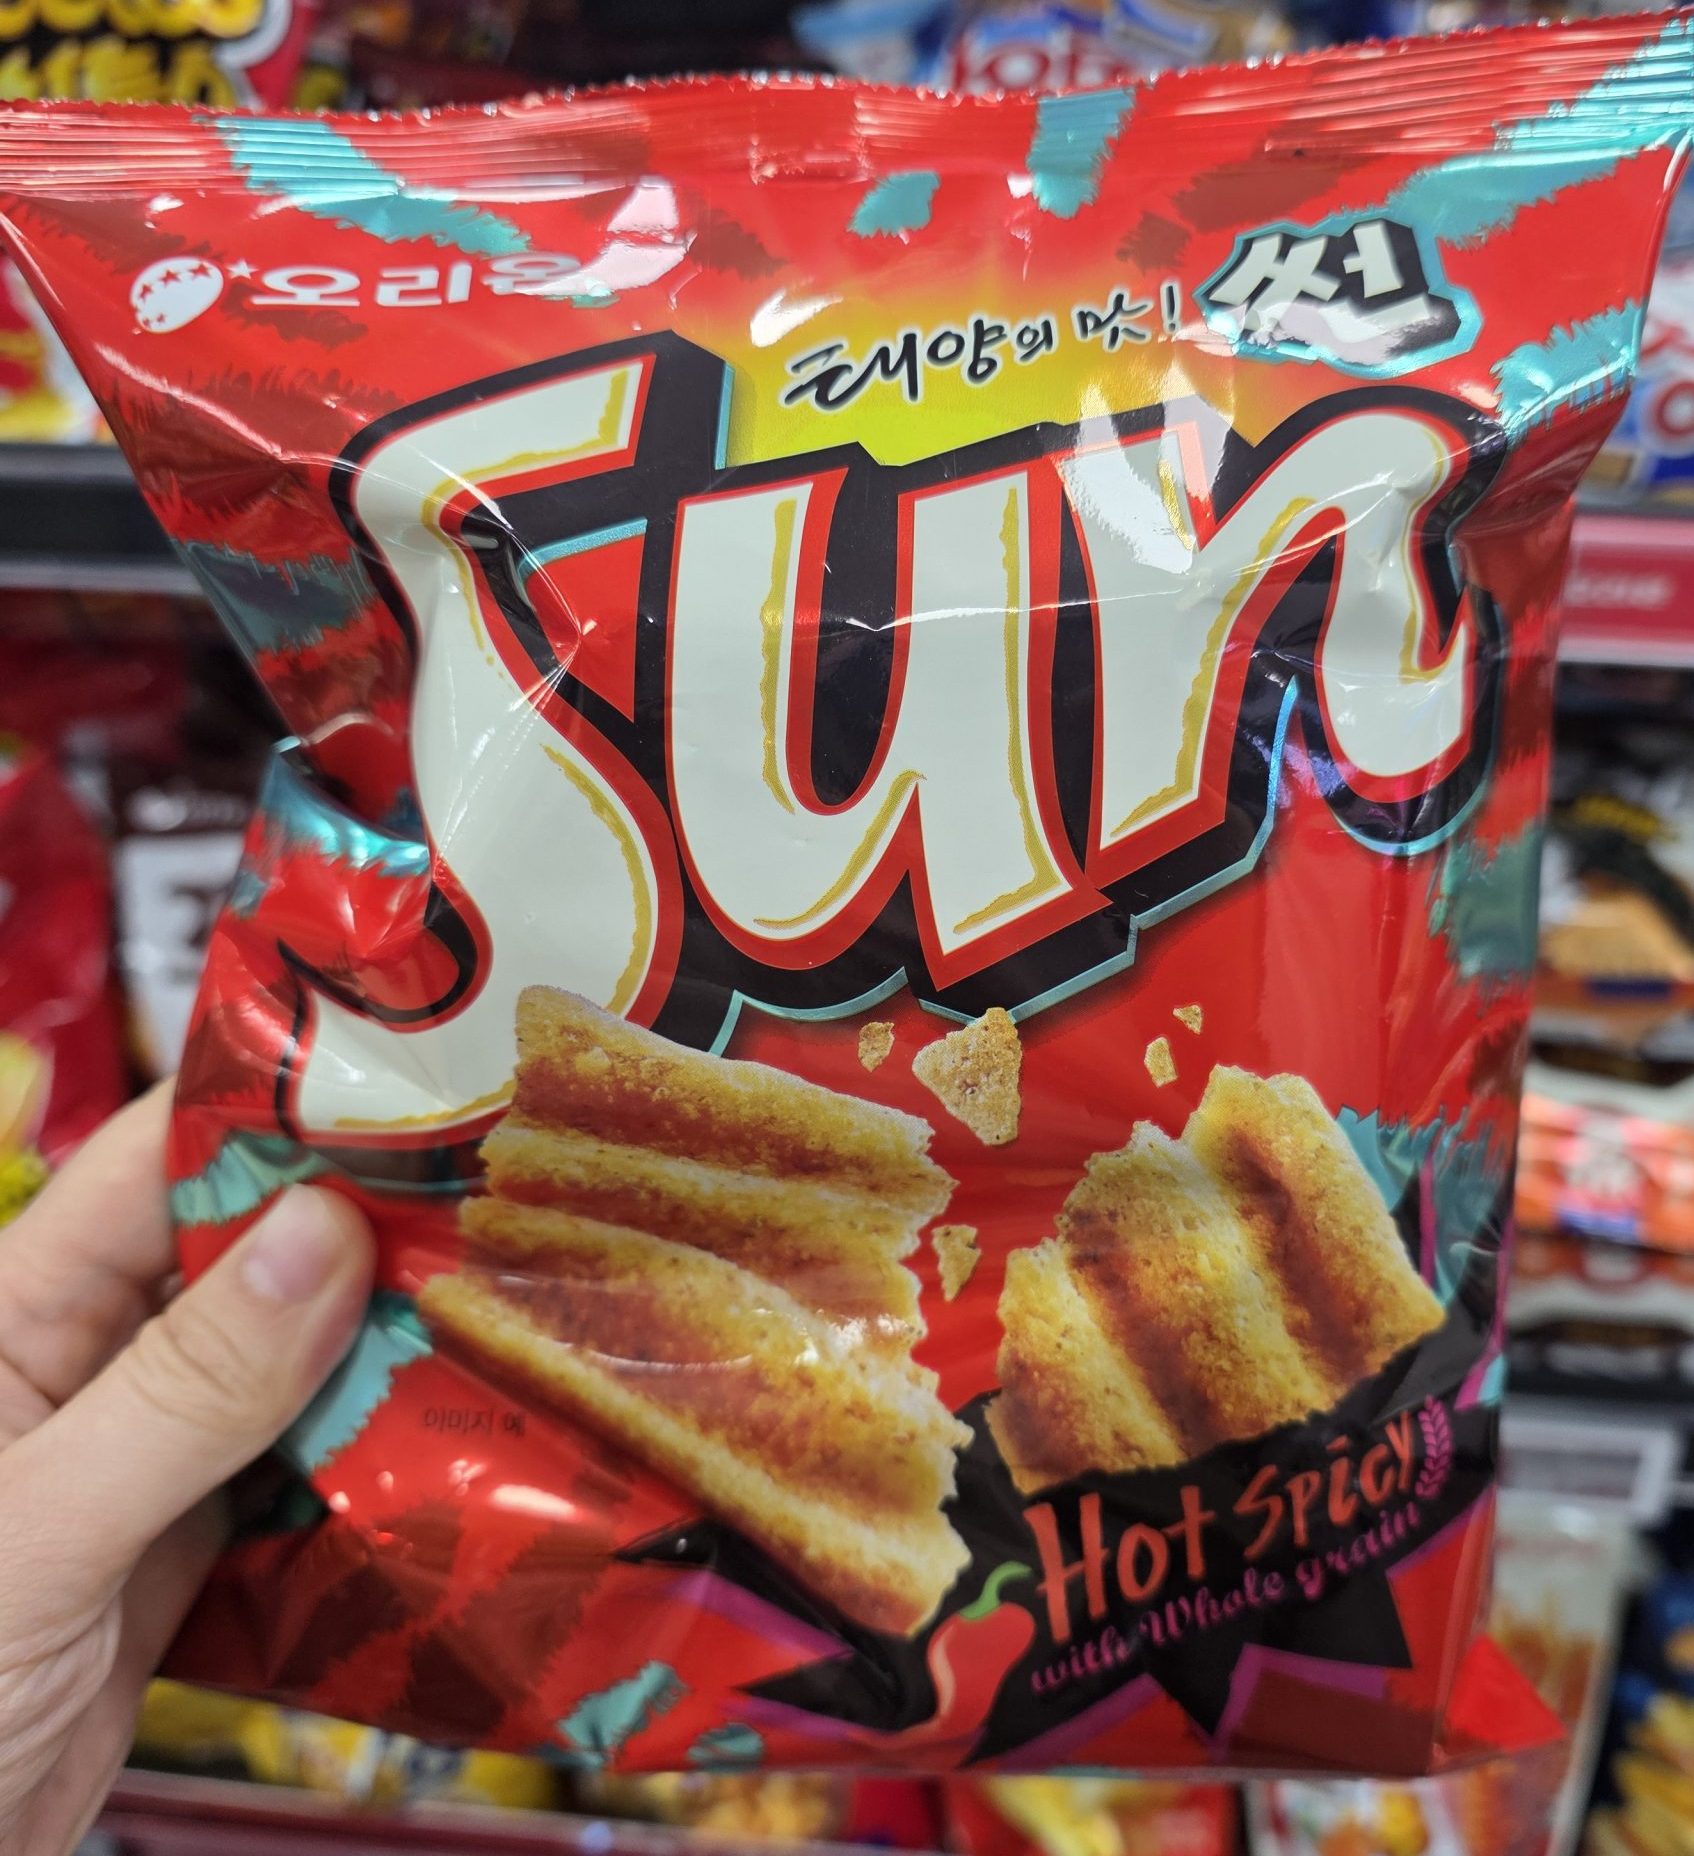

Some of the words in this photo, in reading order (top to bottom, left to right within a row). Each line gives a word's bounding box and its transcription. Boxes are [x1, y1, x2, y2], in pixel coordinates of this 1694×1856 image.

[783, 316, 1056, 412] 태양의
[1075, 283, 1182, 352] 맛!
[1207, 218, 1434, 345] 썬
[287, 345, 1482, 1150] Sun
[423, 1407, 494, 1435] 이미지
[1022, 1484, 1218, 1645] Hot
[1232, 1409, 1414, 1562] Spicy
[1030, 1624, 1132, 1696] with
[1139, 1566, 1288, 1647] Whole
[1295, 1499, 1422, 1601] grain
